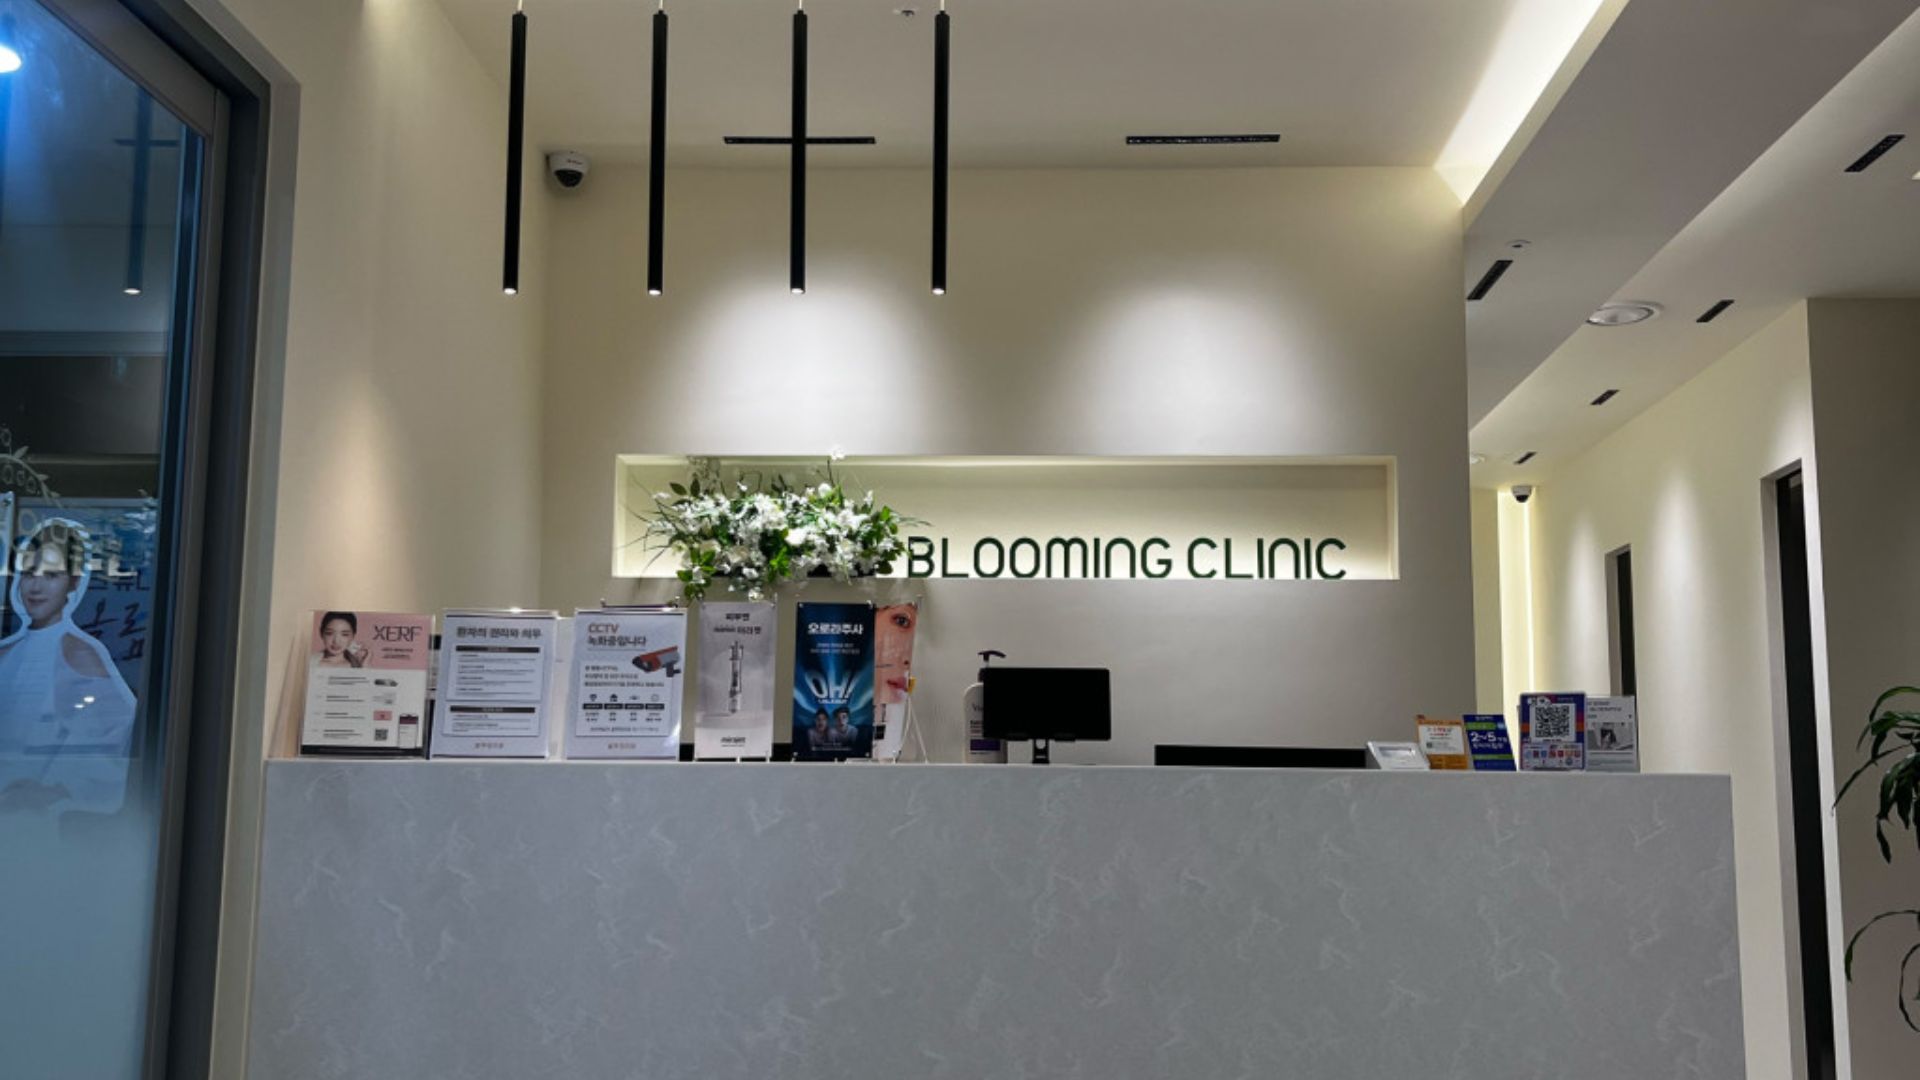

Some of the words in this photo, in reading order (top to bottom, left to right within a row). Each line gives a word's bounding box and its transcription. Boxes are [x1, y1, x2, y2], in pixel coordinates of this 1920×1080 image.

[907, 536, 1172, 579] BLOOMING
[1188, 537, 1347, 579] CLINIC
[372, 625, 423, 642] XERF
[588, 623, 620, 633] CCTV
[588, 636, 647, 647] 녹화중입니다
